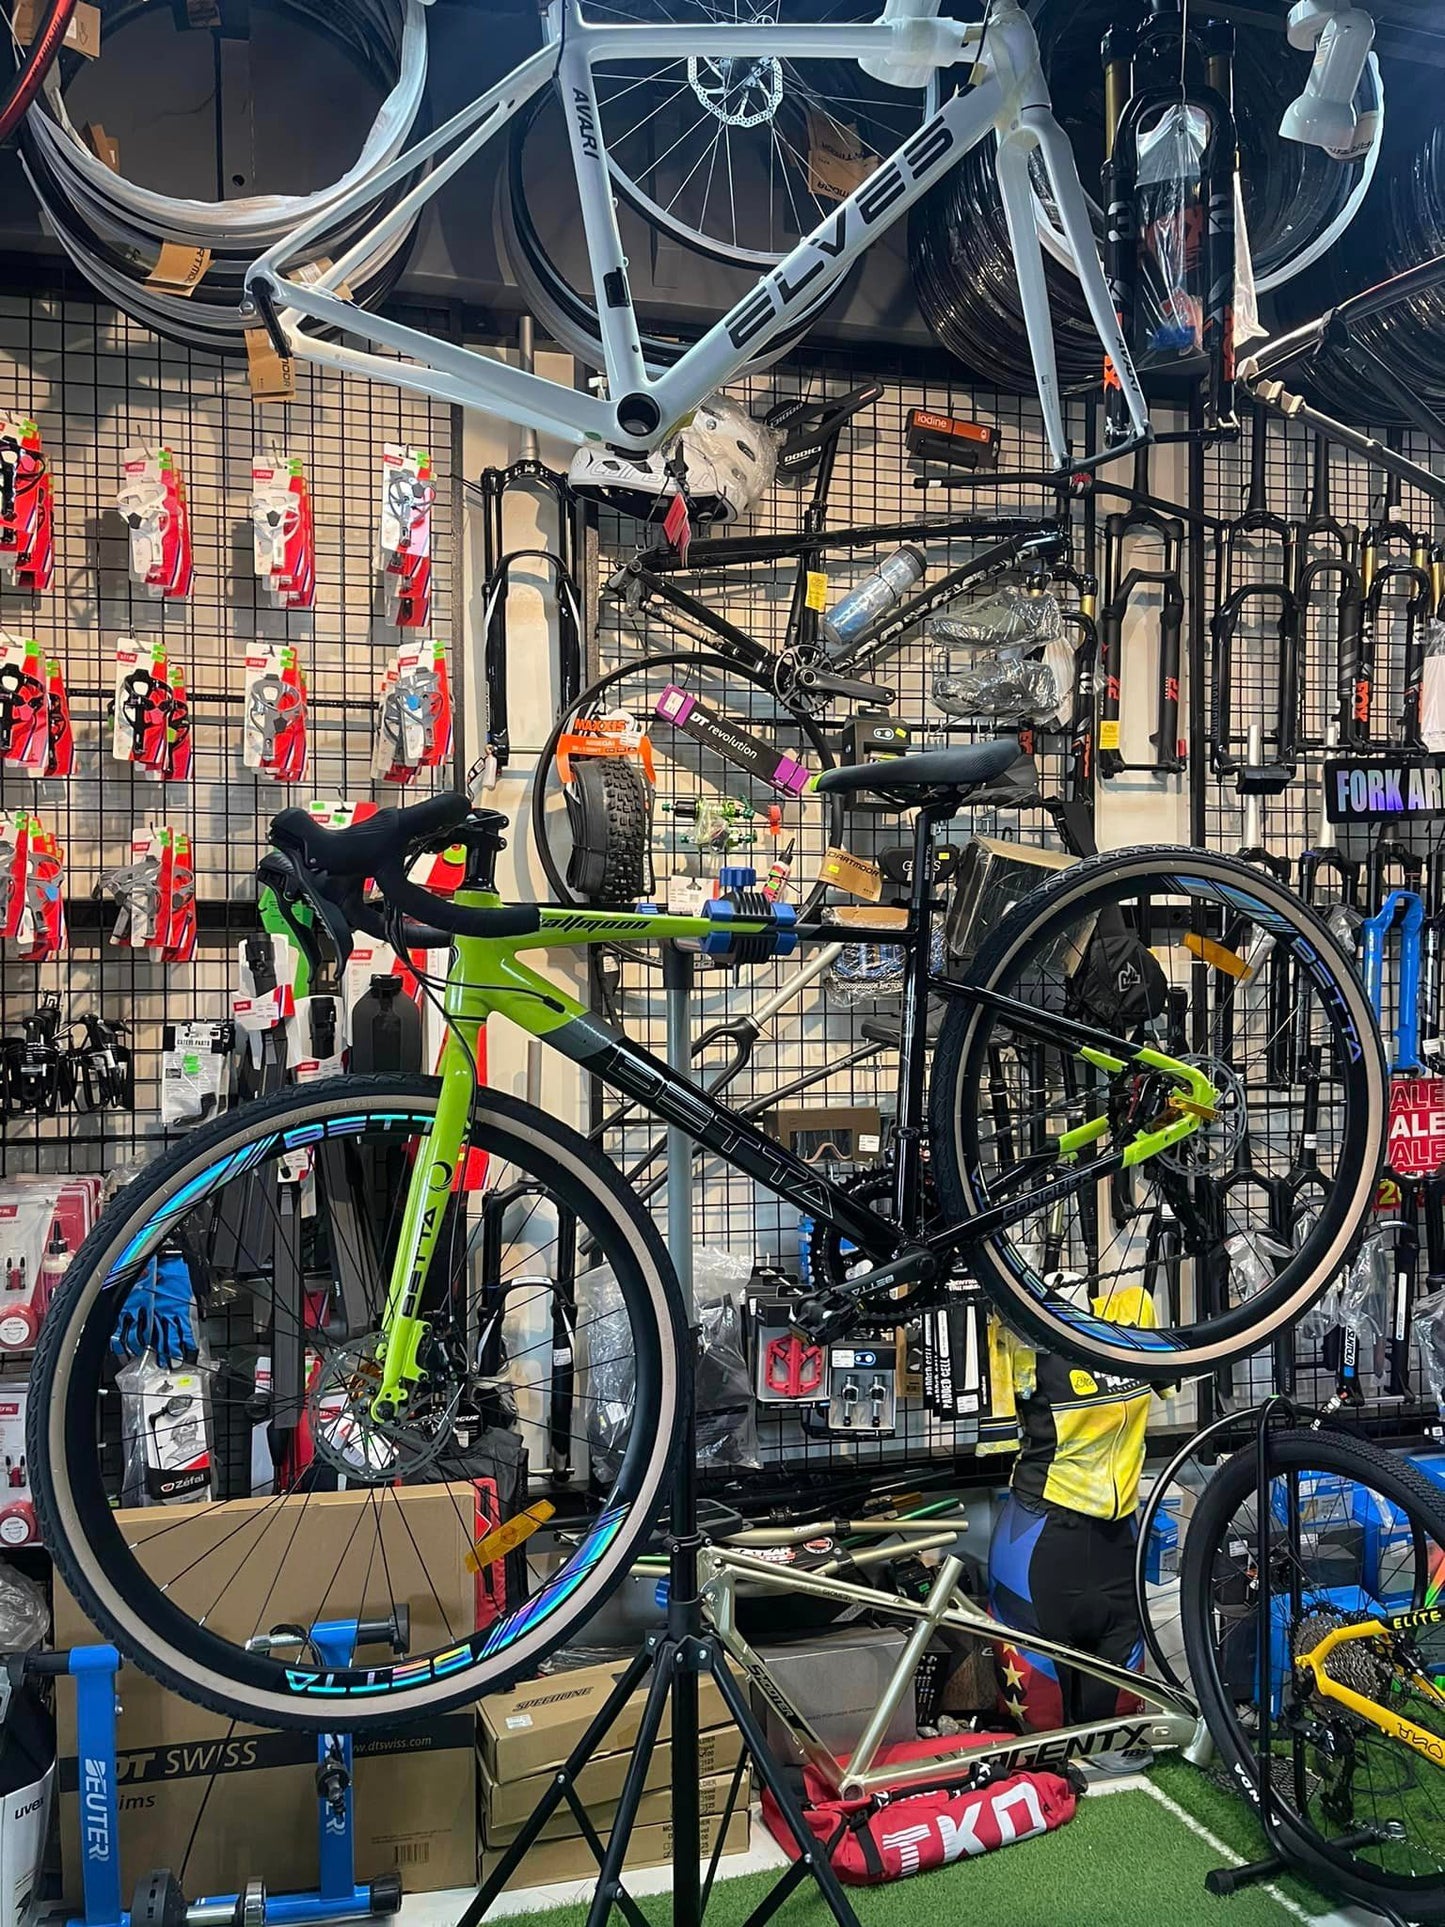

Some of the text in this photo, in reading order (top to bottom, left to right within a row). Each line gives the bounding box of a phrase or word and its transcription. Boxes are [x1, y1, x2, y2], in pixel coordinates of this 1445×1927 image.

[571, 87, 600, 161] AVARI
[723, 114, 954, 350] ELVES
[917, 412, 948, 429] iodine
[784, 446, 822, 462] DODICI
[1355, 680, 1369, 723] FOX
[574, 719, 627, 732] MAXXIS
[688, 711, 759, 760] DT revolution
[1336, 768, 1405, 813] FORK
[826, 850, 880, 877] DARTMOOR
[1290, 936, 1362, 1065] BETTA
[1390, 1085, 1445, 1112] ALE
[283, 1114, 436, 1149] BETT
[606, 1047, 834, 1220] BETTA
[1390, 1111, 1445, 1139] ALE
[1390, 1139, 1445, 1168] ALE
[402, 1206, 438, 1318] BETTA
[851, 1274, 895, 1296] BETTA
[941, 1377, 953, 1409] PADDED
[175, 1474, 204, 1489] Zéfal
[285, 1643, 474, 1691] BETTA
[749, 1664, 795, 1718] SHOOTER
[164, 1740, 258, 1775] SWISS
[84, 1758, 110, 1862] BEUTER
[118, 1794, 156, 1811] ims
